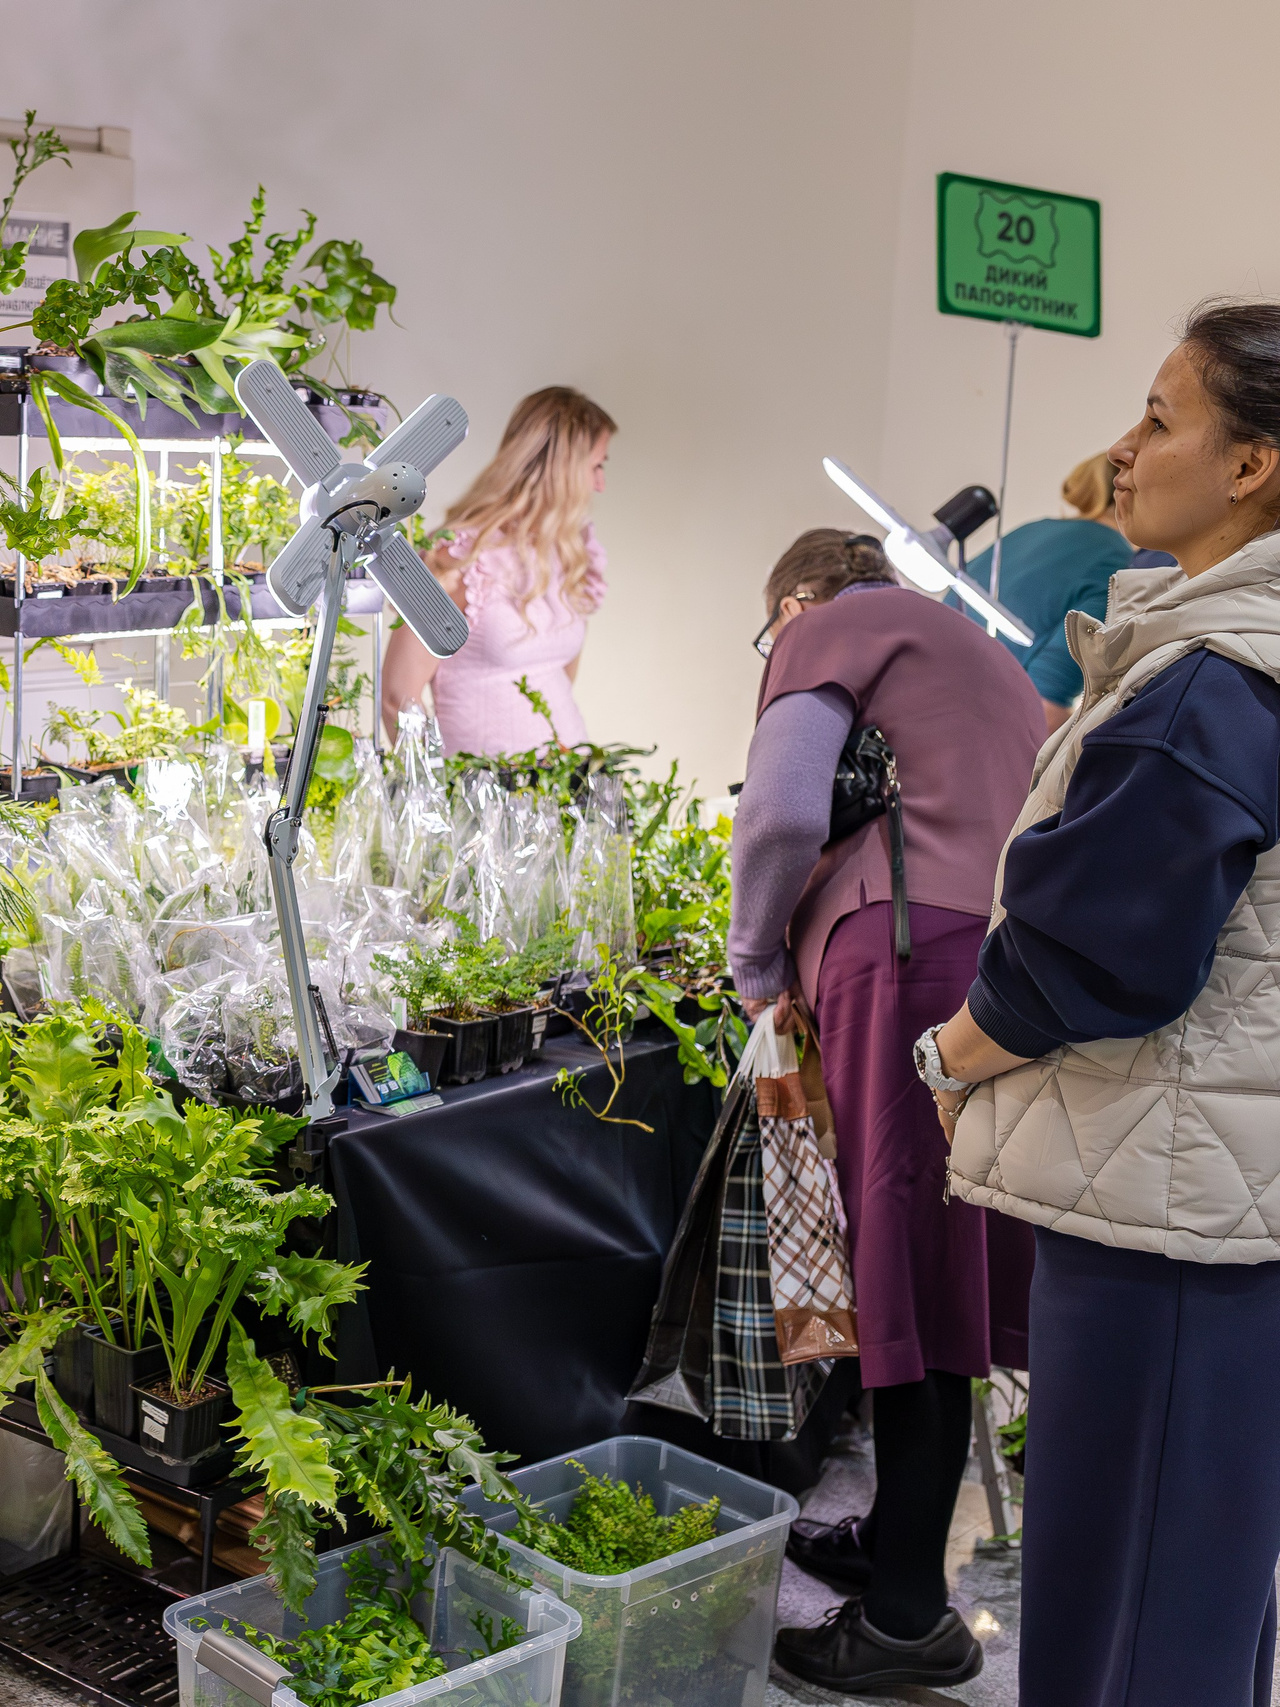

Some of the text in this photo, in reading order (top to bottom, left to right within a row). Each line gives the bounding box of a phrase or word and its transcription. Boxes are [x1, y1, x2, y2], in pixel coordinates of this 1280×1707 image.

[998, 213, 1035, 245] 20
[986, 265, 1048, 291] ДИКИЙ
[955, 283, 1078, 320] ПАПОРОТНИК
